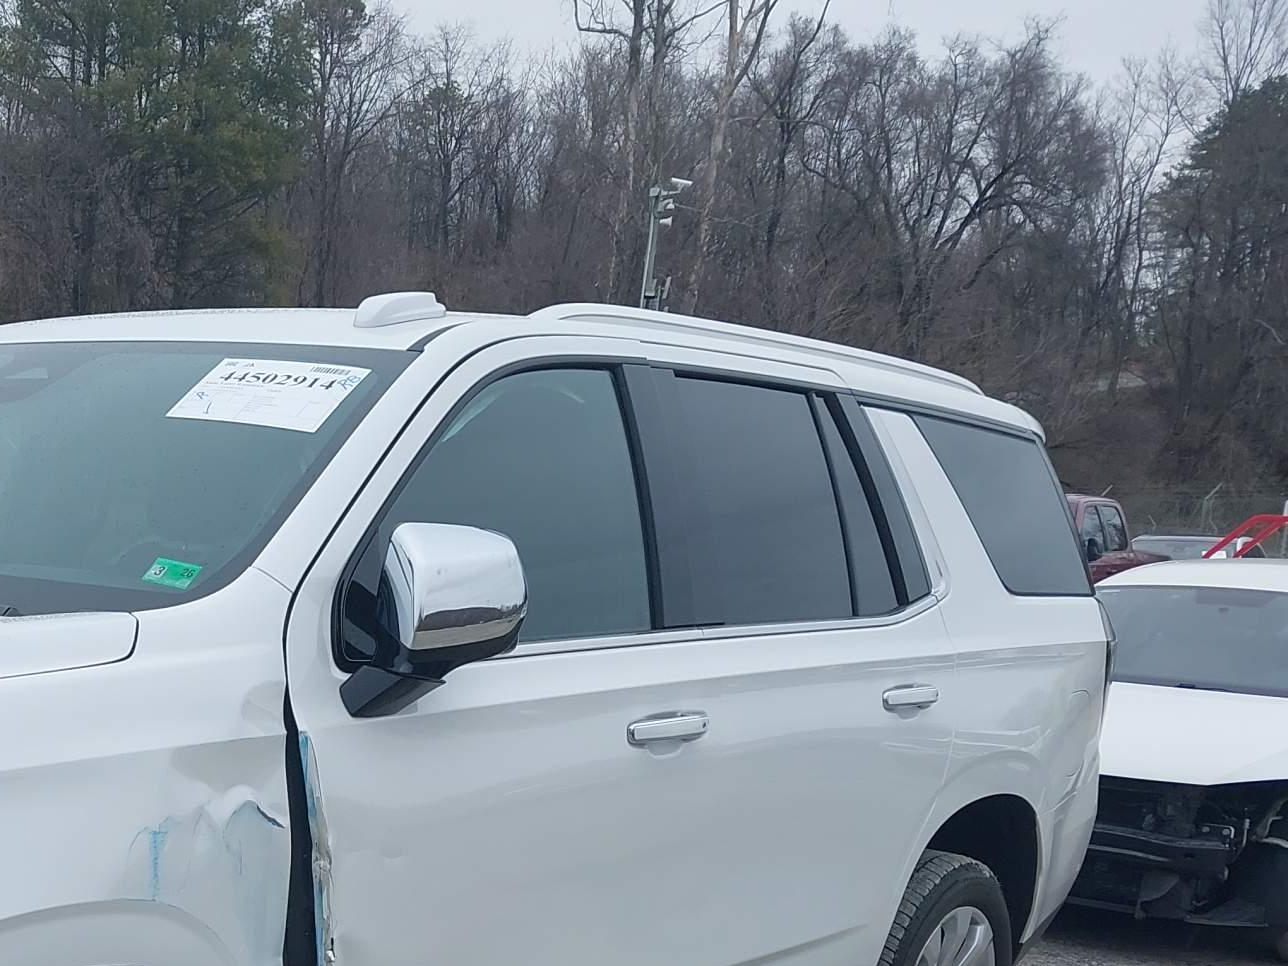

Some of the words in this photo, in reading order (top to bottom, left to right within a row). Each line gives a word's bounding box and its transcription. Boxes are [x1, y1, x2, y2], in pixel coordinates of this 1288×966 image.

[219, 370, 338, 390] 44502914
[153, 565, 166, 576] 3
[179, 568, 196, 578] 26
